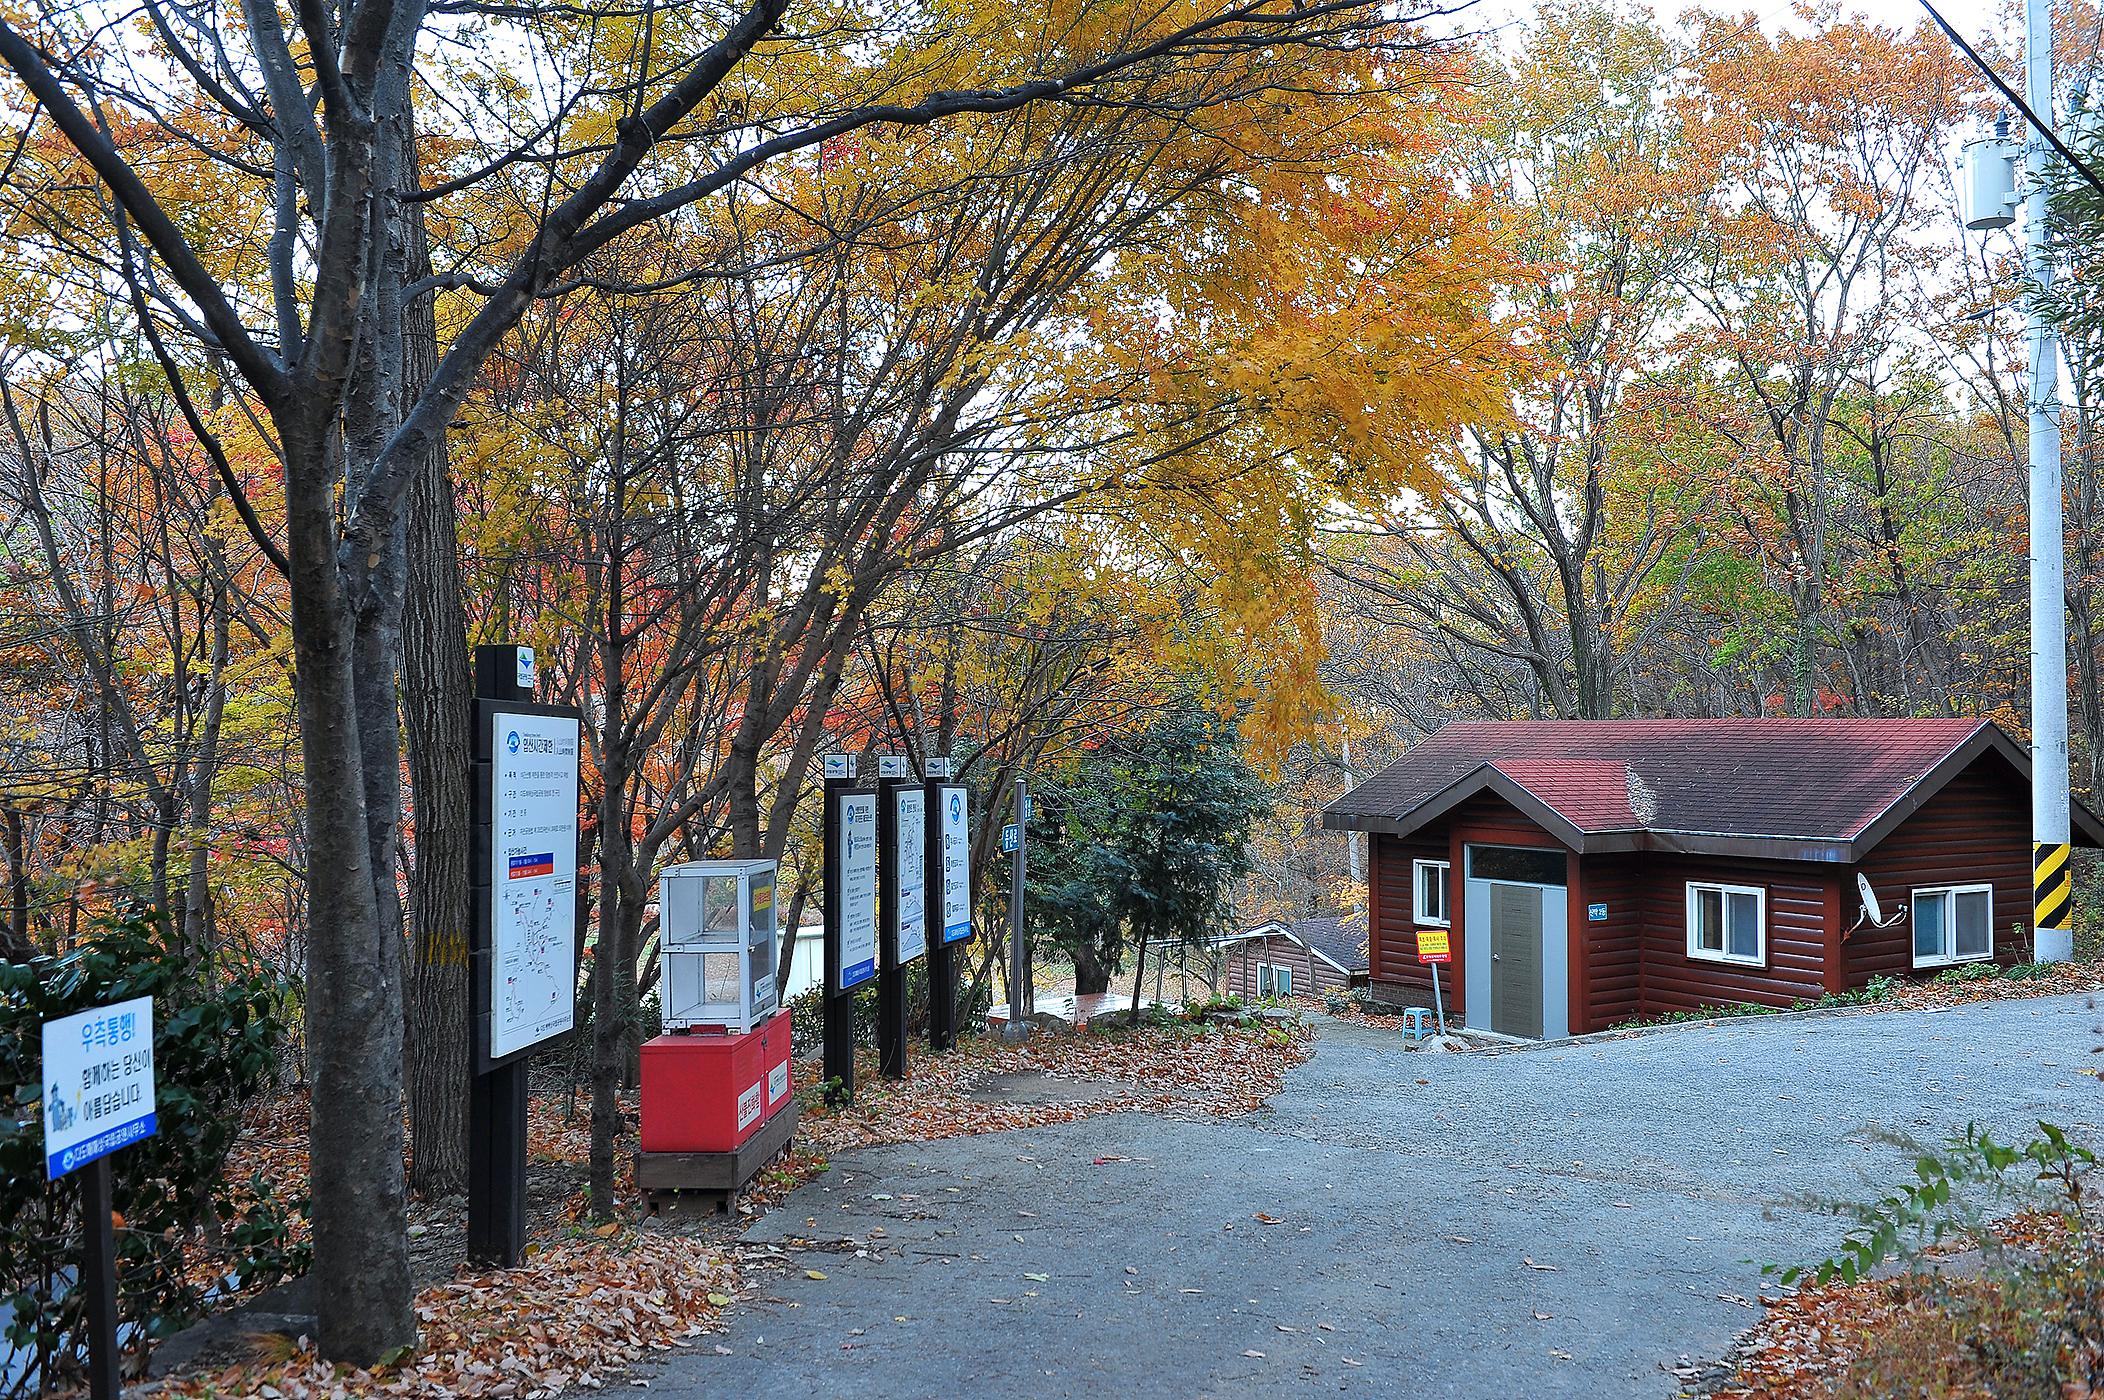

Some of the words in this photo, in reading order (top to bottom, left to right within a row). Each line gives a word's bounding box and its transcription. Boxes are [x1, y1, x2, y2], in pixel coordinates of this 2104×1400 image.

[522, 738, 553, 754] 입산시간제한
[1004, 829, 1018, 849] 등산로
[81, 1012, 136, 1053] 우측통행!
[81, 1060, 120, 1091] 함께하는
[122, 1048, 151, 1077] 당신이
[83, 1083, 142, 1122] 아름답습니다.
[739, 1091, 760, 1122] 산불진화함
[74, 1121, 147, 1162] 다도해해상국립공원사무소
